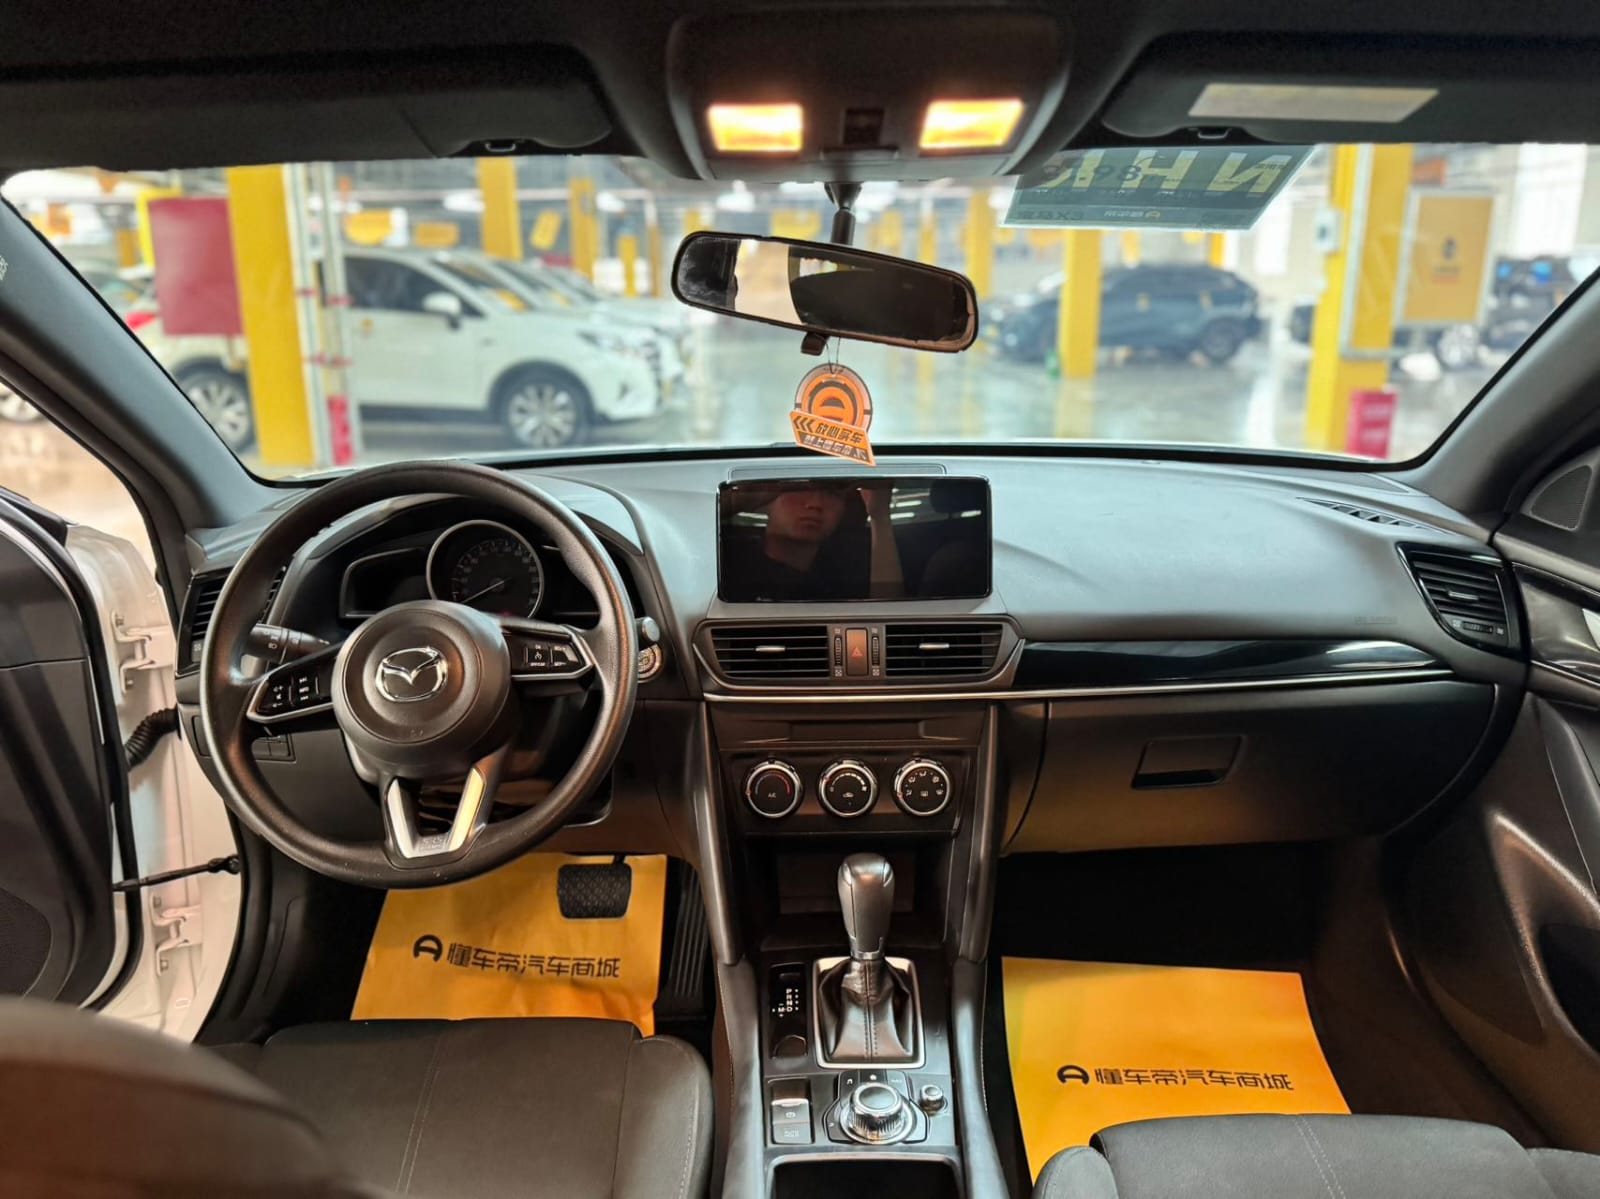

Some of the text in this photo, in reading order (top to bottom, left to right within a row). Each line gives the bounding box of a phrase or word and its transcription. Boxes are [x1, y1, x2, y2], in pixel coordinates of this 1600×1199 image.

[816, 423, 864, 444] 放心买车
[447, 942, 620, 978] 懂车帝汽车商城
[1095, 1067, 1294, 1090] 懂车帝汽车商城
